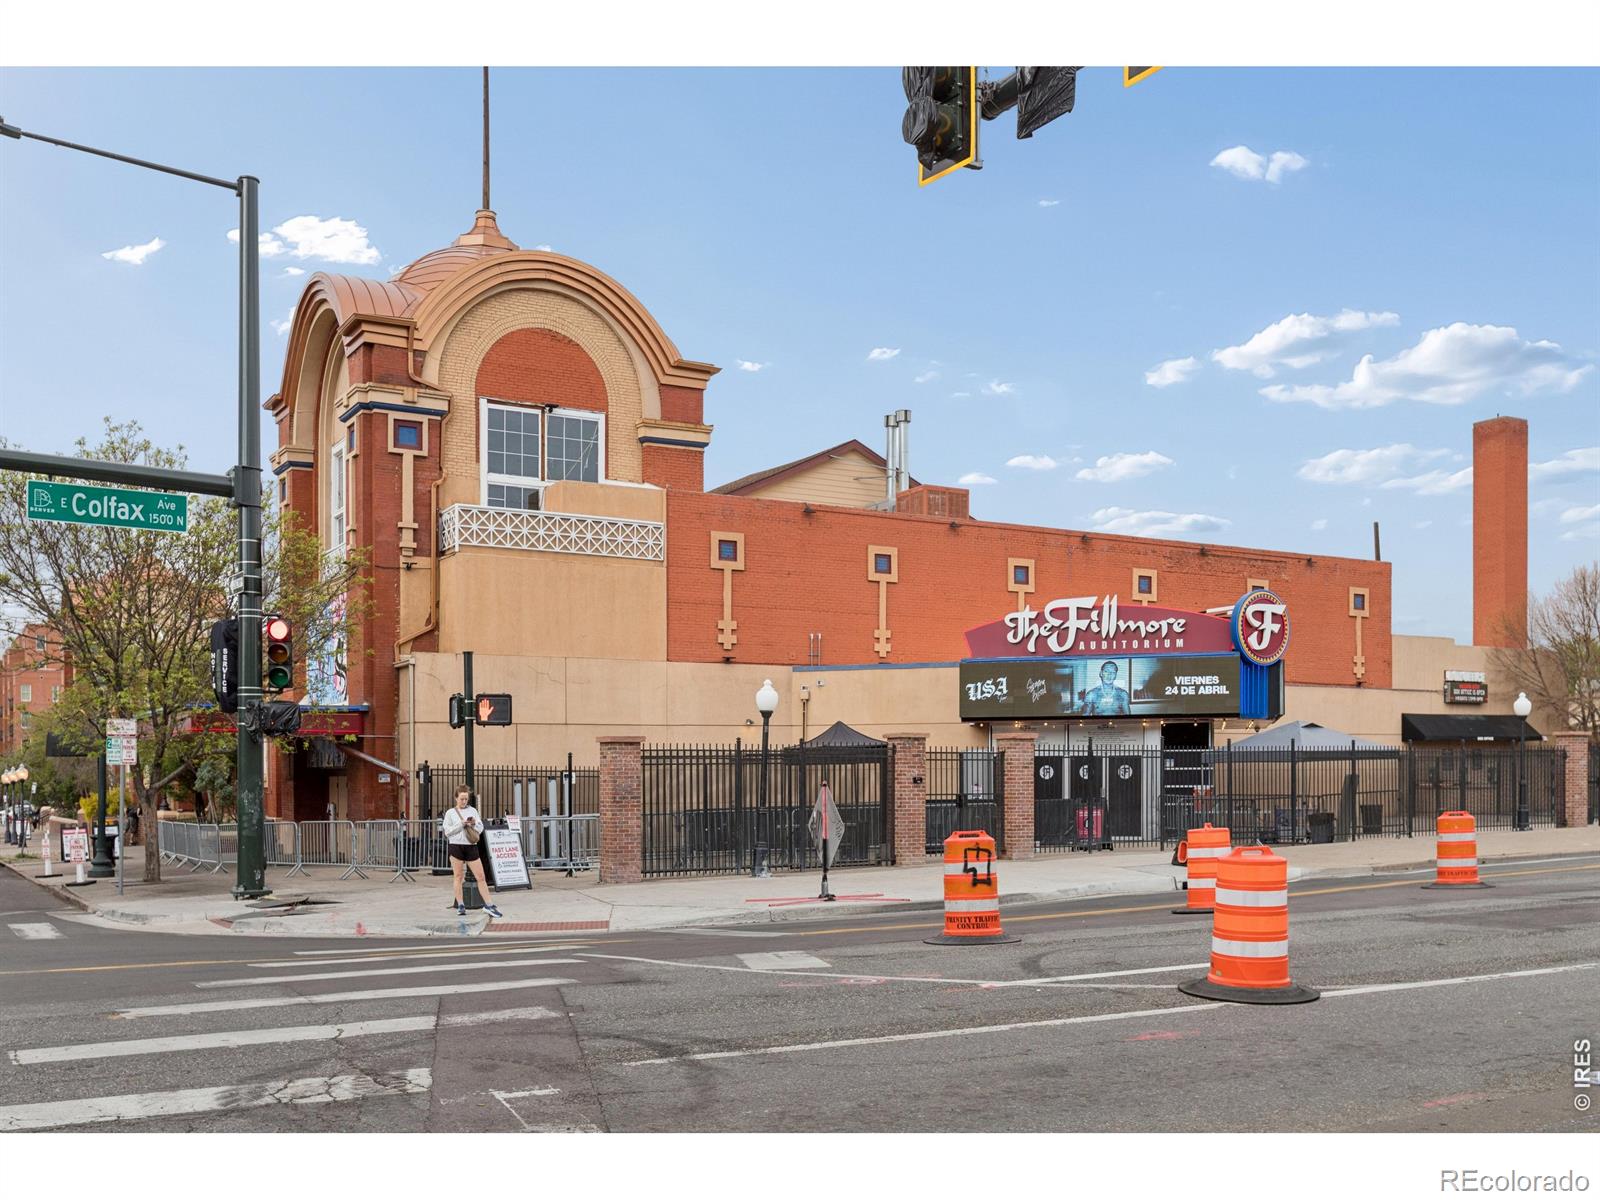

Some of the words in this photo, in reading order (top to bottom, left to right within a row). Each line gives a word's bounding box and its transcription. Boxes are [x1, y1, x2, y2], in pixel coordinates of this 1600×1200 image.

[60, 497, 67, 508] E
[72, 492, 145, 521] Colfax
[157, 499, 176, 511] Ave
[149, 513, 173, 525] 1500
[176, 516, 184, 526] N
[1004, 604, 1053, 653] The
[1043, 594, 1187, 653] Fillmore
[1245, 603, 1287, 651] F
[1079, 638, 1185, 650] AUDITORIUM
[1174, 675, 1220, 685] VIERNES
[965, 676, 1008, 701] USA
[1165, 686, 1179, 695] 24
[1180, 686, 1196, 695] DE
[1198, 685, 1230, 695] ABRIL
[956, 922, 989, 930] CONTROL
